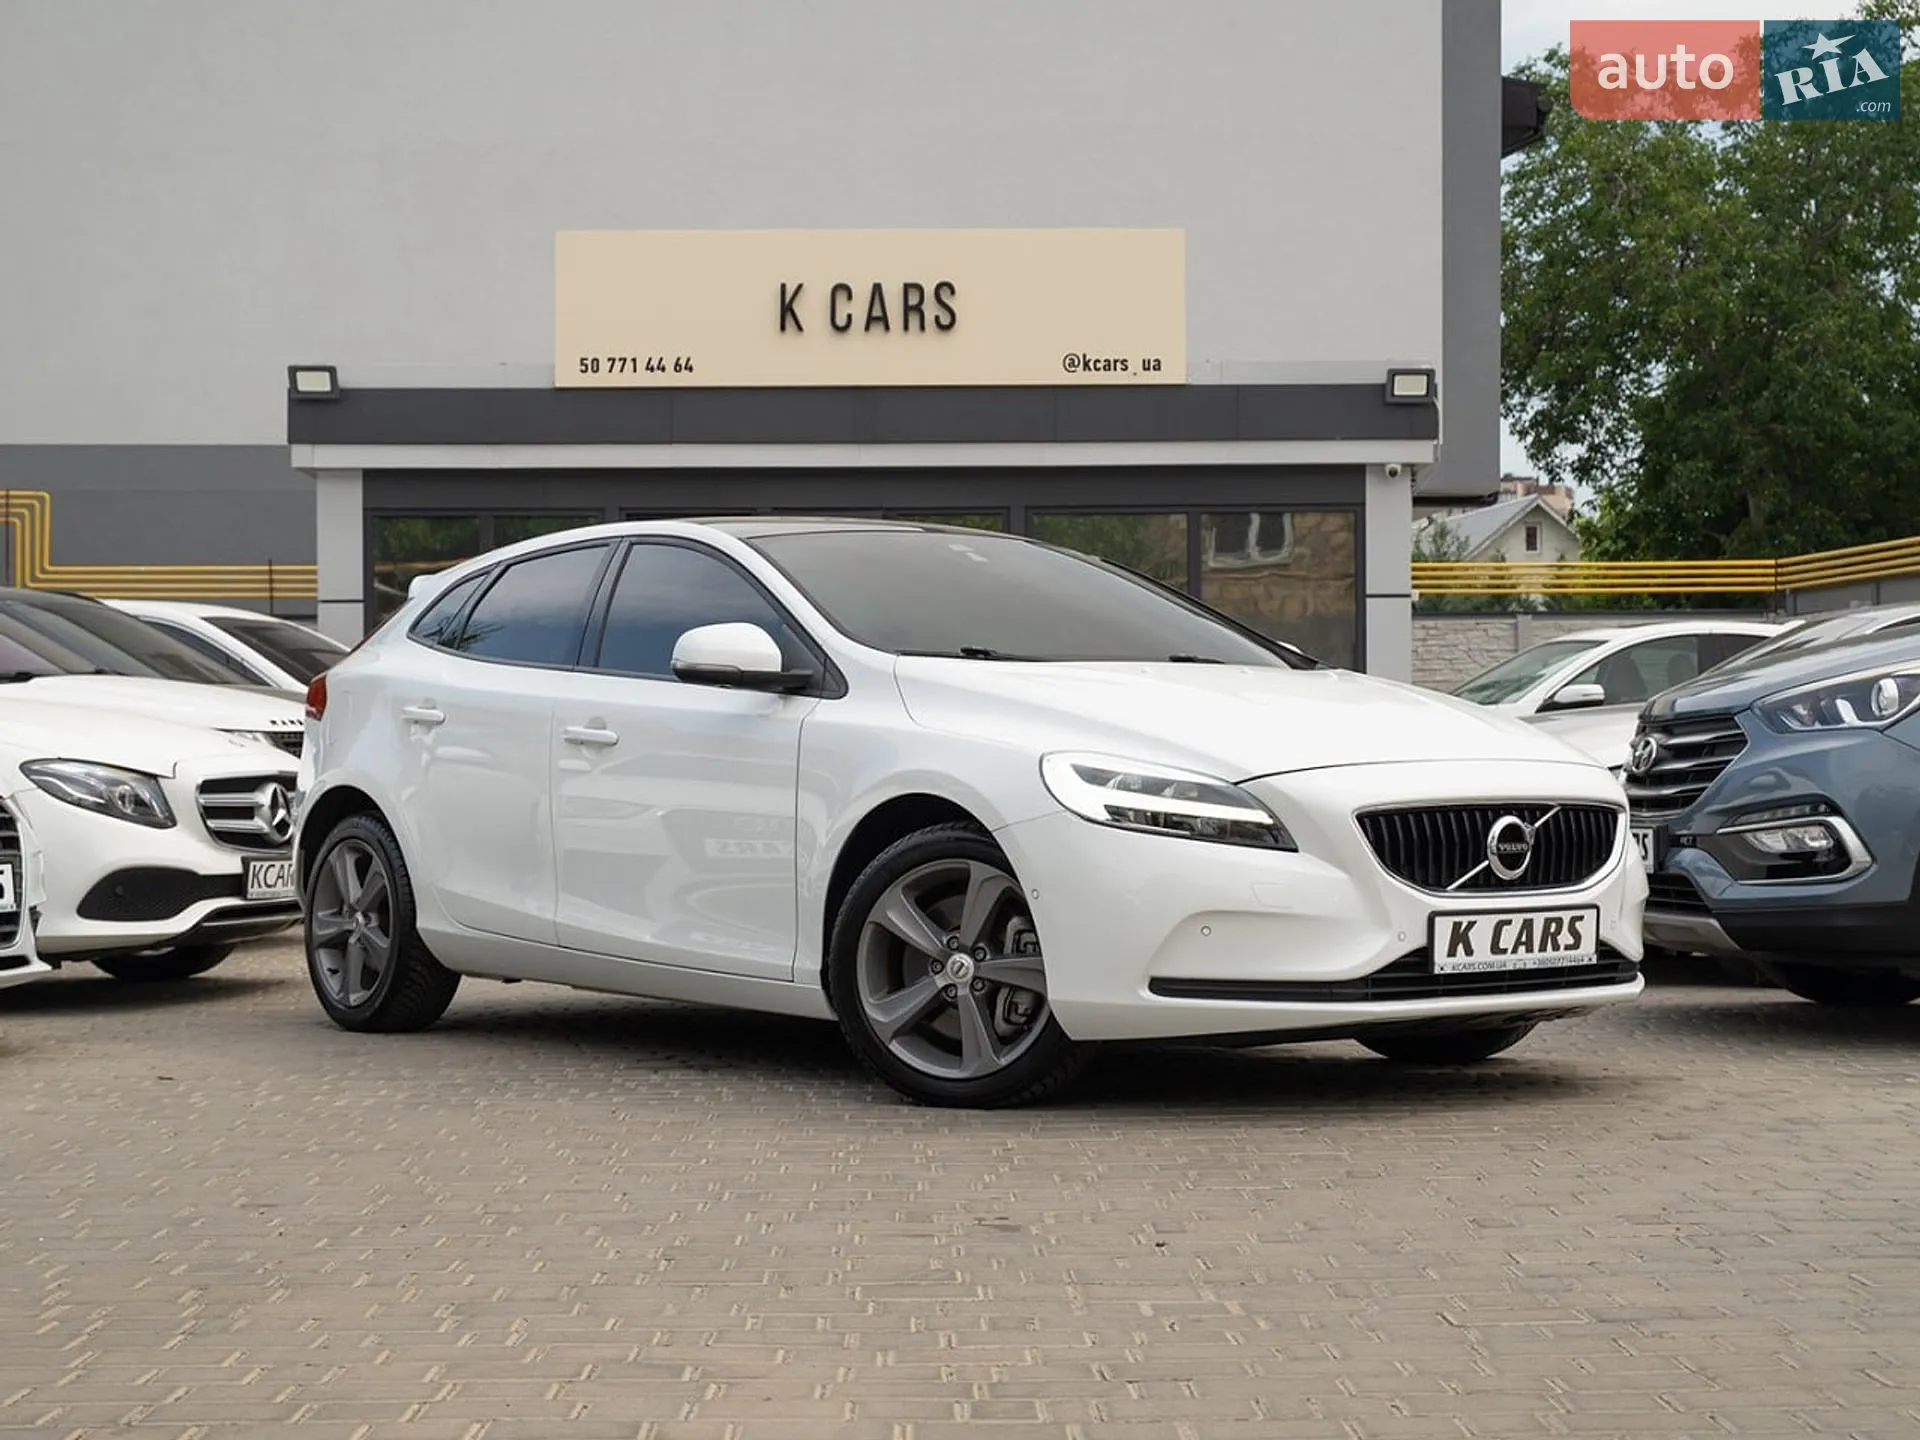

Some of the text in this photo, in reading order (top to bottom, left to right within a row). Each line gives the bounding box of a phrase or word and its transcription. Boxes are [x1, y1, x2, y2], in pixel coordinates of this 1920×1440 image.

[779, 280, 957, 333] K CARS
[579, 356, 694, 374] 50 771 44 64
[1632, 832, 1649, 861] S
[1446, 914, 1585, 958] K CARS
